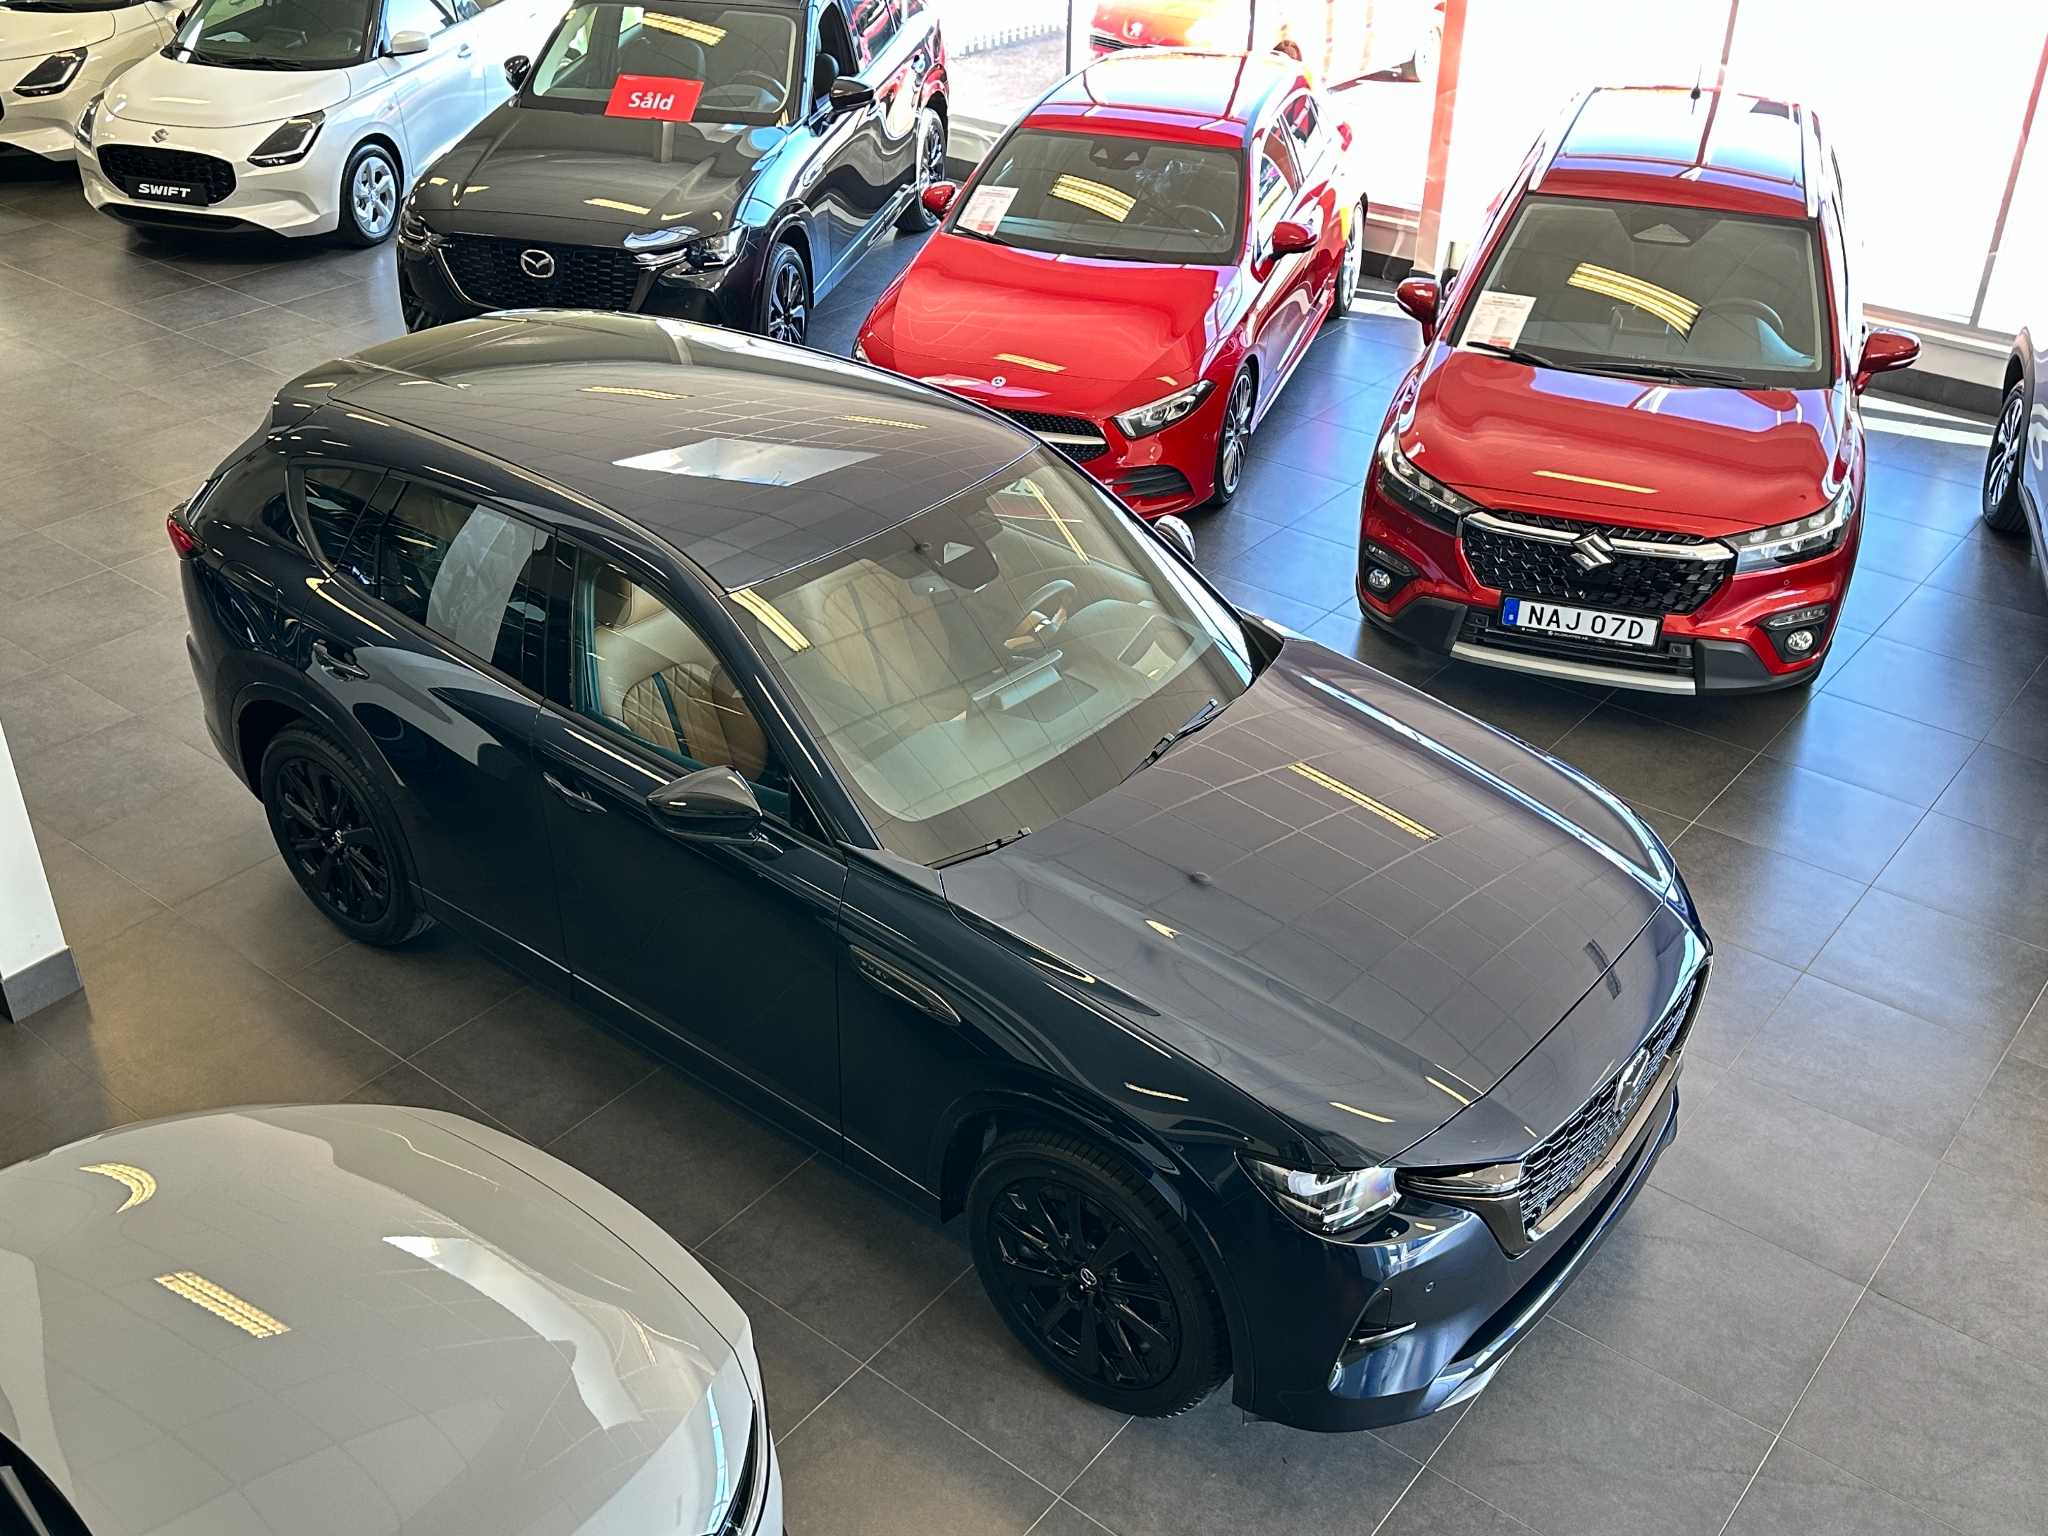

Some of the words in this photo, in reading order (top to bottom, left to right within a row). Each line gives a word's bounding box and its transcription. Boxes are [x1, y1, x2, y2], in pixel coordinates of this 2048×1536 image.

[628, 91, 675, 111] Såld
[138, 183, 191, 198] SWIFT
[1528, 605, 1581, 631] NAJ
[1591, 615, 1644, 640] 07D
